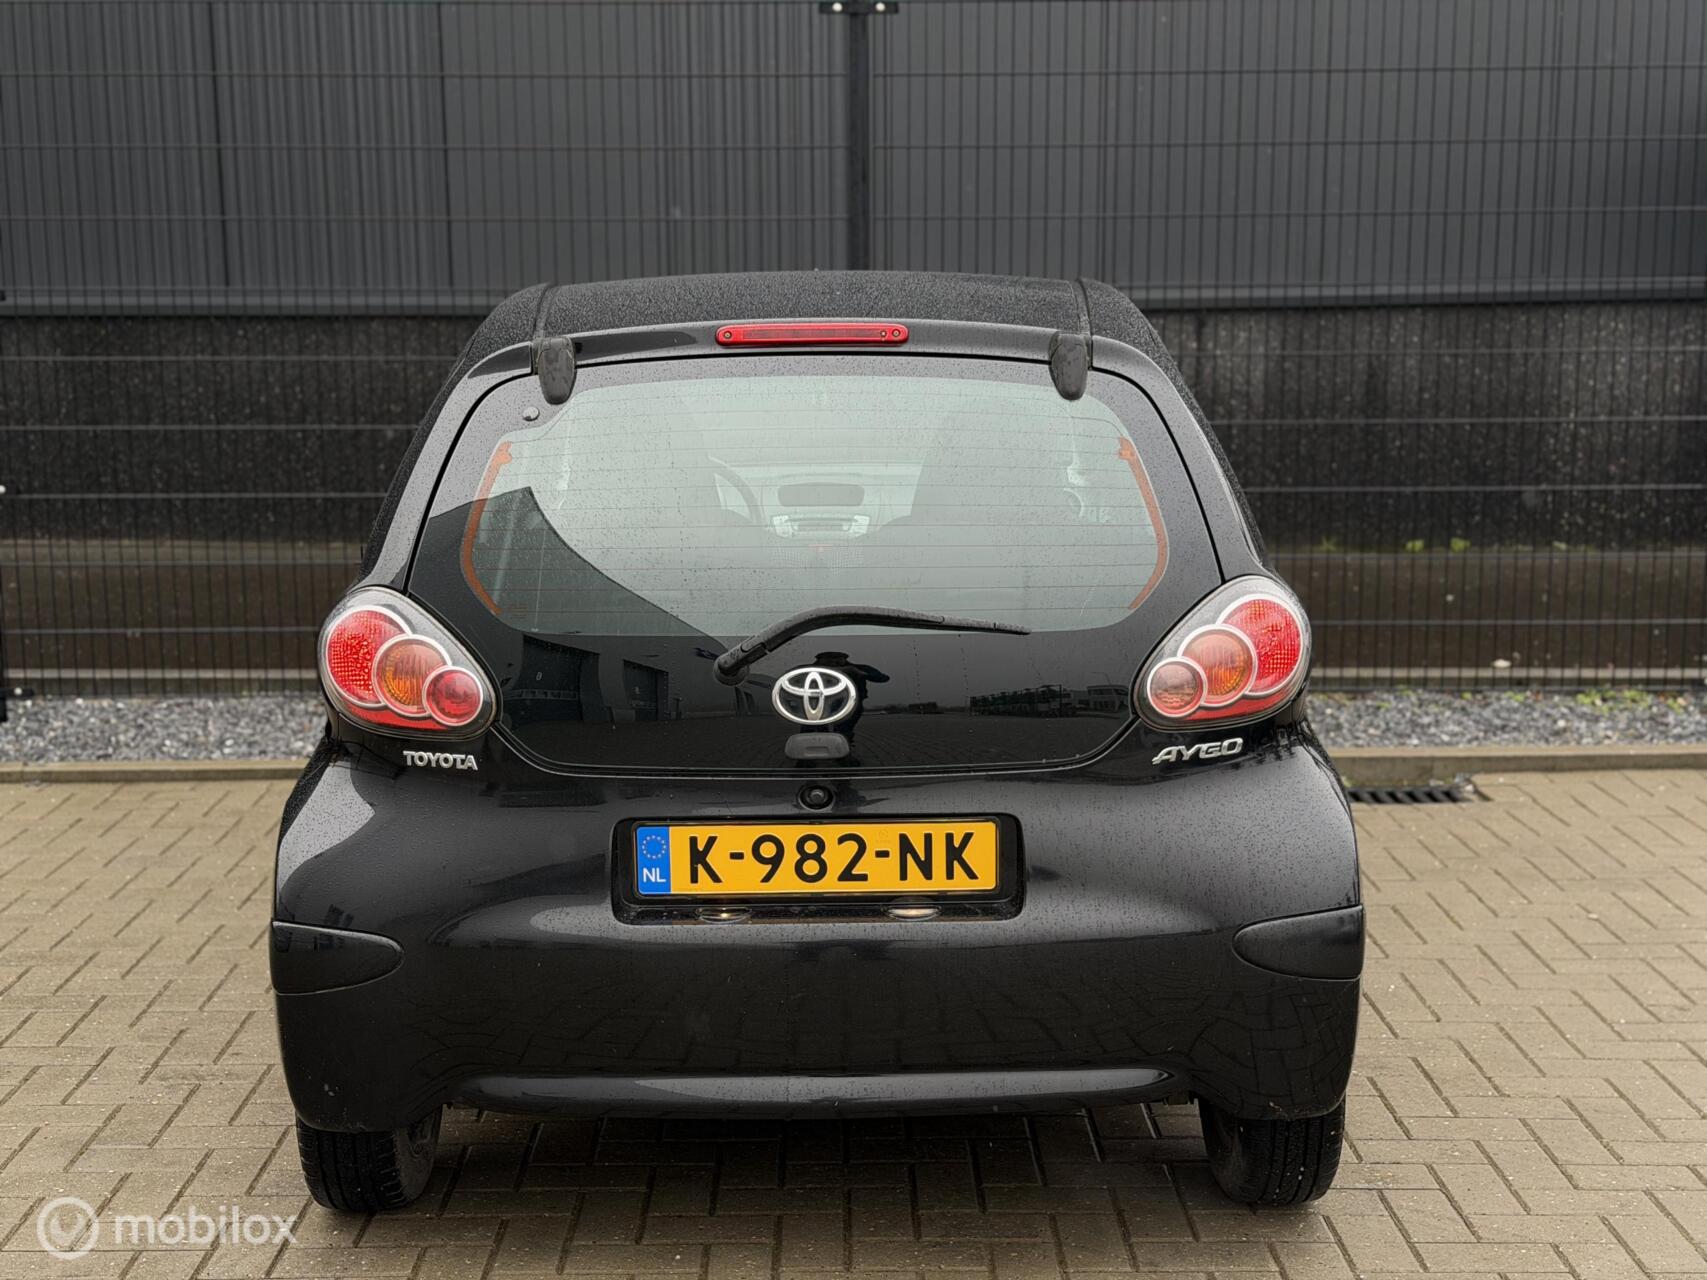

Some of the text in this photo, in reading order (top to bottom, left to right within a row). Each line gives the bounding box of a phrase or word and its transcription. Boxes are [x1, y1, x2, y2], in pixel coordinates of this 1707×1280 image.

[402, 750, 478, 771] TOYOTA
[1152, 737, 1243, 765] AYGO
[689, 832, 979, 884] K-982-NK
[642, 868, 667, 883] NL
